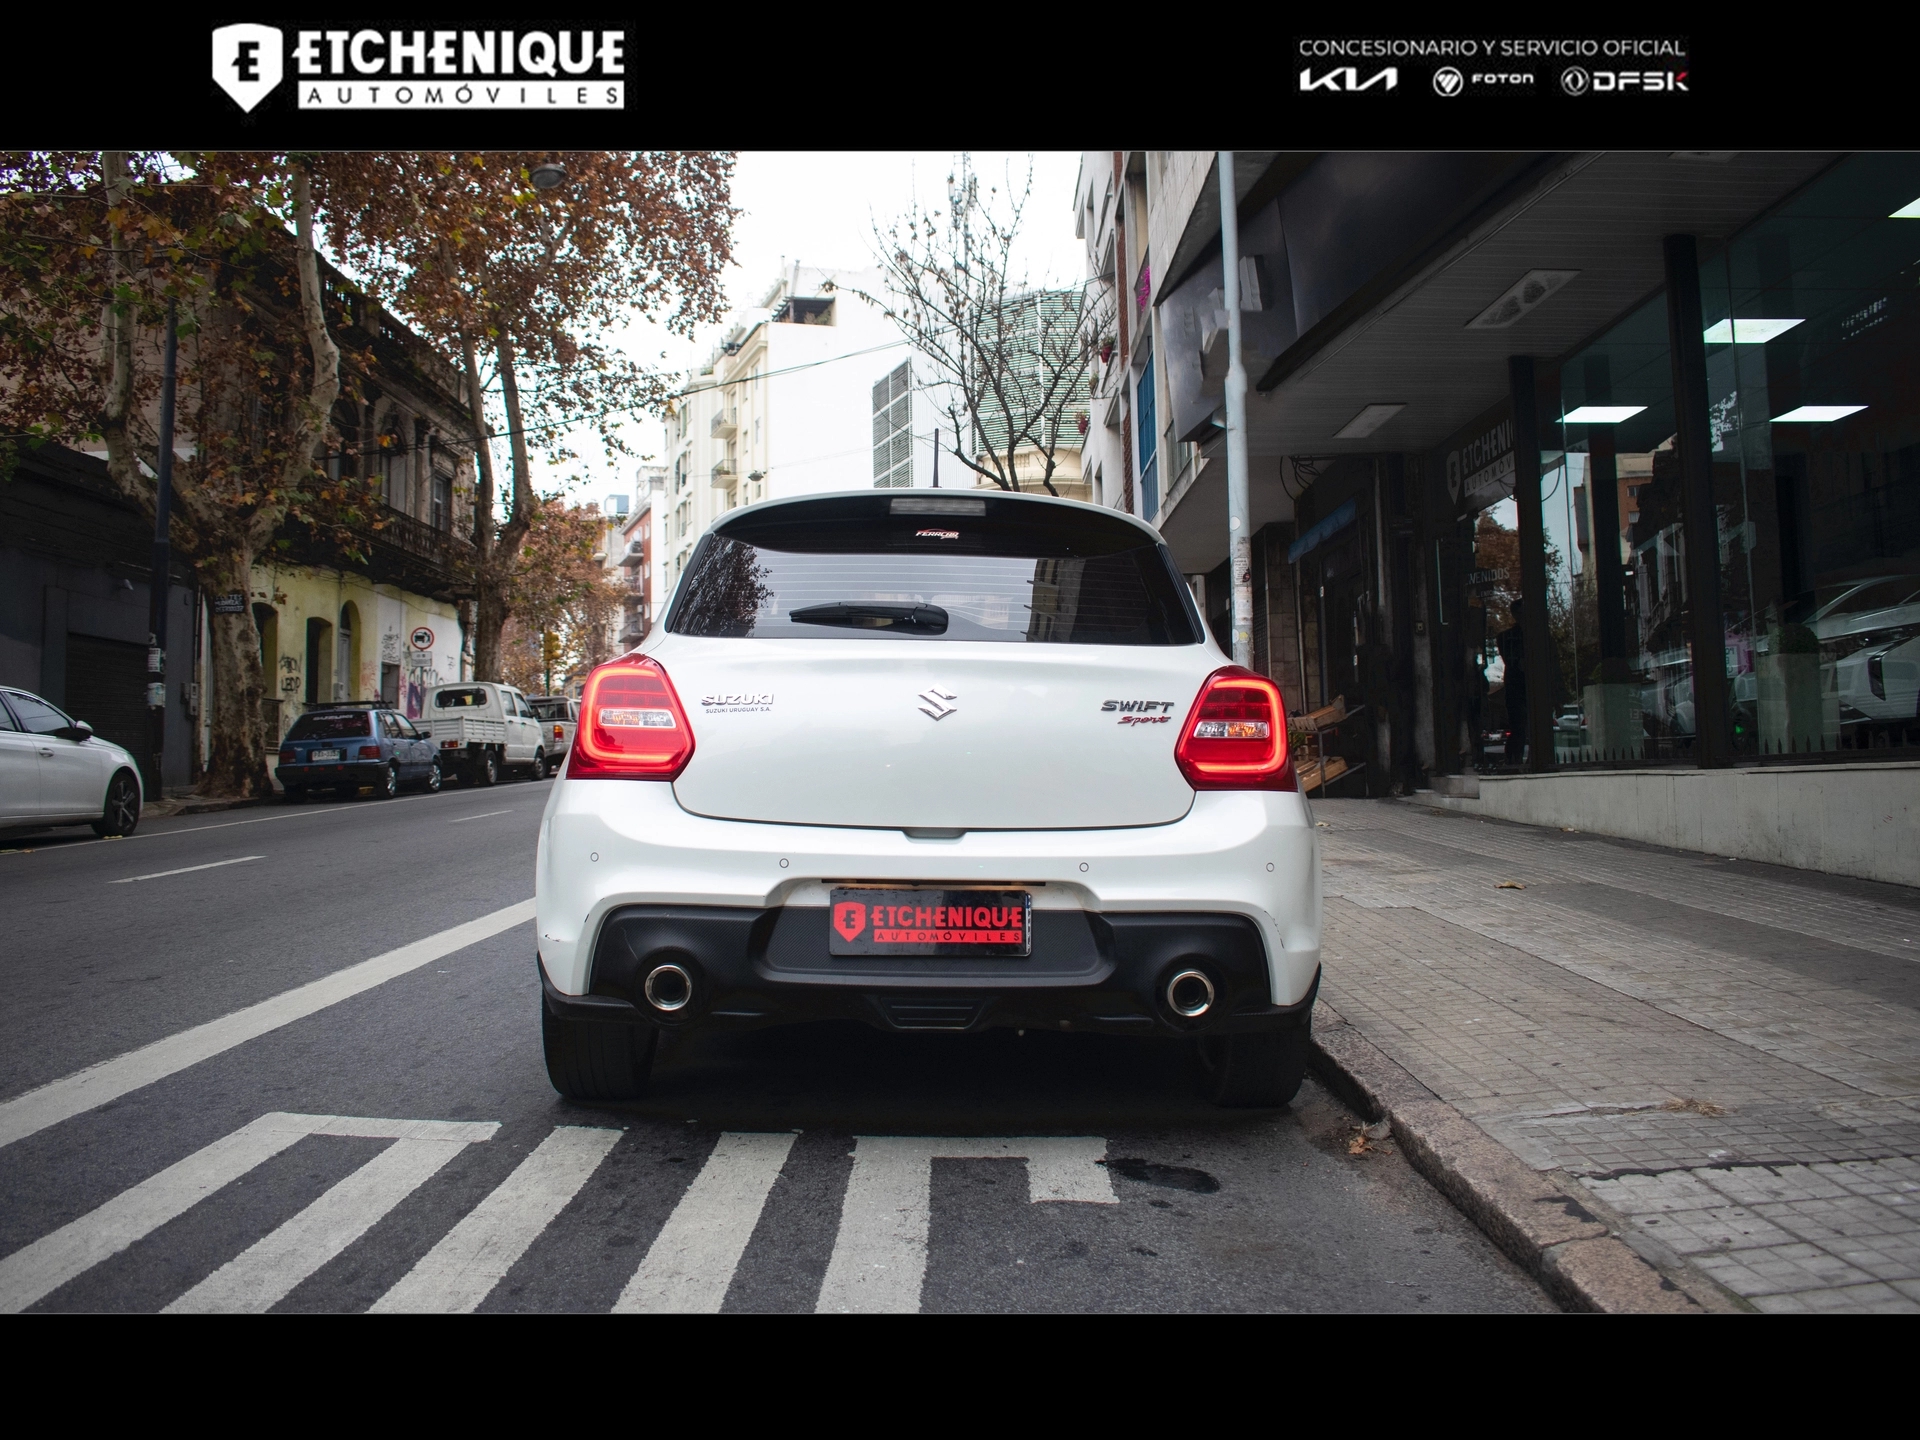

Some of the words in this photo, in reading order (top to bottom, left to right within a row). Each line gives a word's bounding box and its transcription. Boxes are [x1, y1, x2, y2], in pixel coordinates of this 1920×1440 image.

[1462, 419, 1514, 475] ETCHENI
[701, 693, 774, 706] SUZUKI
[1100, 699, 1174, 713] SWIFT
[1117, 716, 1171, 727] Sport
[870, 905, 1022, 928] ETCHENIQUE
[877, 931, 1020, 942] AUTOMÓVILES
